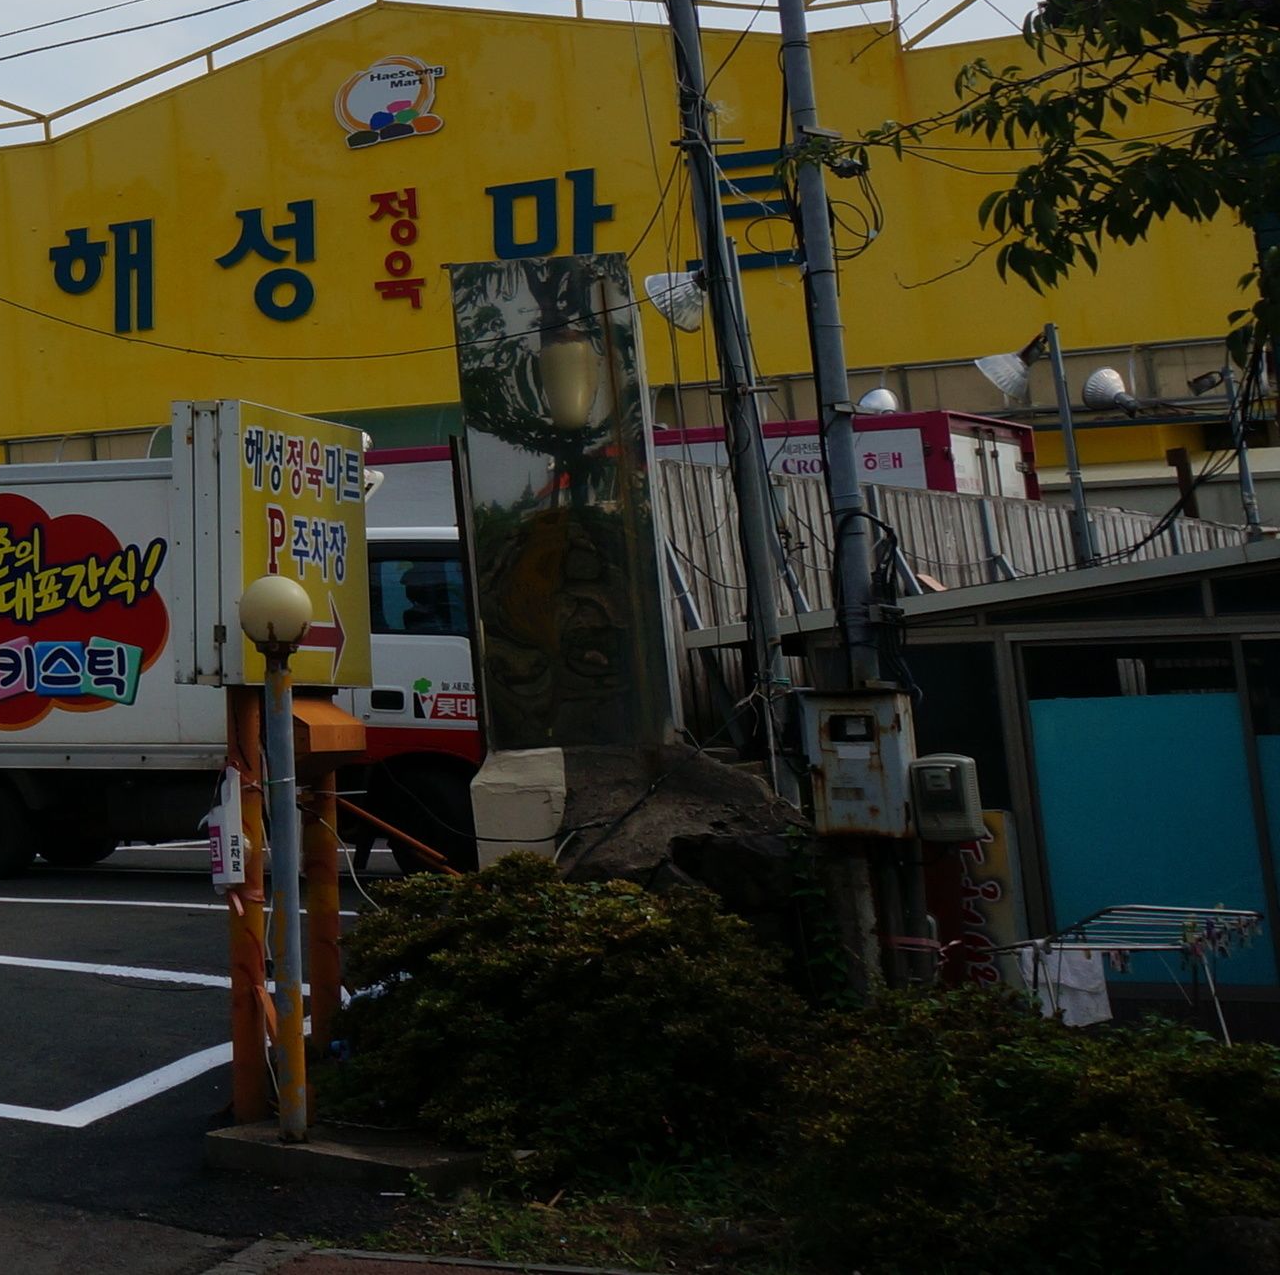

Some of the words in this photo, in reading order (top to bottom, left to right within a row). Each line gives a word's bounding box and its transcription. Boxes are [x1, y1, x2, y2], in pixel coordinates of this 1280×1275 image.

[369, 66, 444, 82] HaeSeong
[389, 78, 425, 89] Mart
[244, 427, 361, 504] 해성정육마트
[781, 458, 824, 475] CRO
[267, 506, 287, 574] P
[292, 518, 348, 582] 주차장
[436, 697, 477, 718] 롯데
